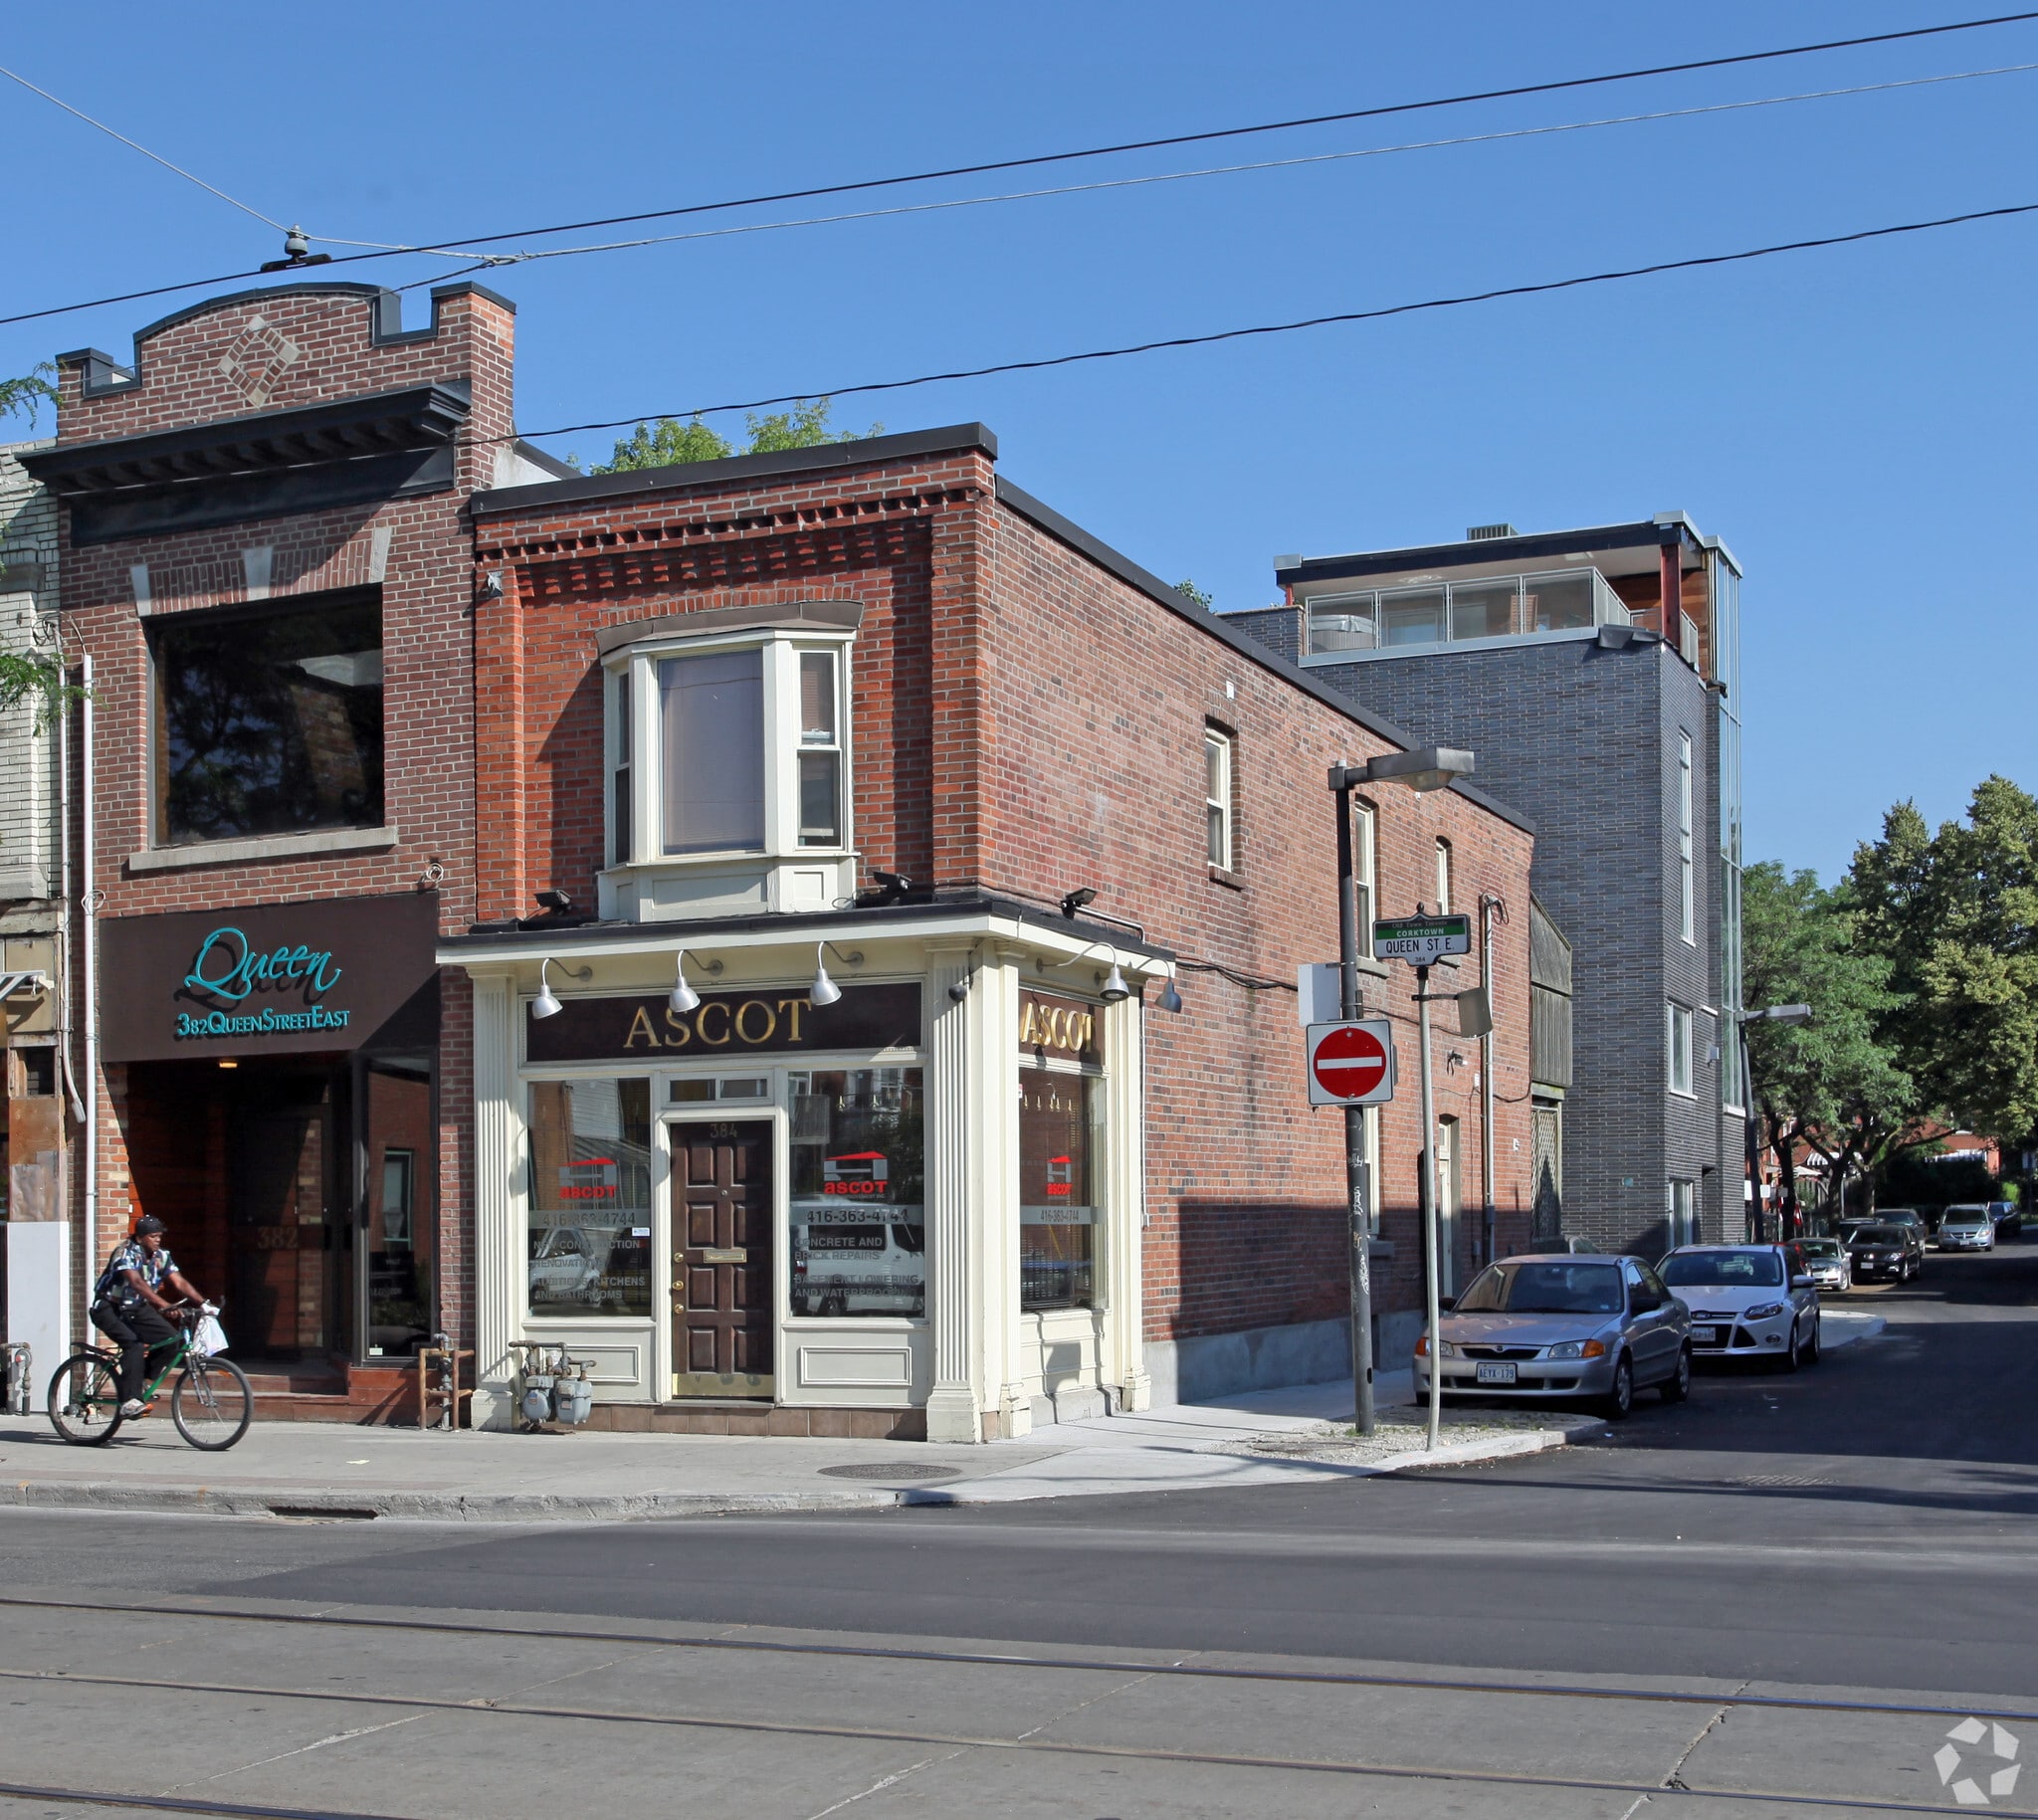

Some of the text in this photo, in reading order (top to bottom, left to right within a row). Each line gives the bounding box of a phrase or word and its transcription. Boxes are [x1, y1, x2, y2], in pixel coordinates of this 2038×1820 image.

[1396, 927, 1444, 937] CORKTOWN
[1385, 937, 1454, 953] QUEEN ST. E.
[184, 926, 342, 999] Queen
[623, 998, 812, 1048] ASCOT
[1020, 1002, 1095, 1053] ASCOT
[710, 1122, 737, 1138] 384
[542, 1212, 636, 1226] 416-363-4744
[807, 1209, 909, 1223] 416-363-4744
[257, 1226, 298, 1249] 382
[794, 1237, 883, 1247] CONCRETE AND
[559, 1240, 641, 1250] CONCTION
[794, 1251, 882, 1260] BRICK REPAIRS
[594, 1276, 646, 1287] KITCHENS
[794, 1288, 819, 1298] AND
